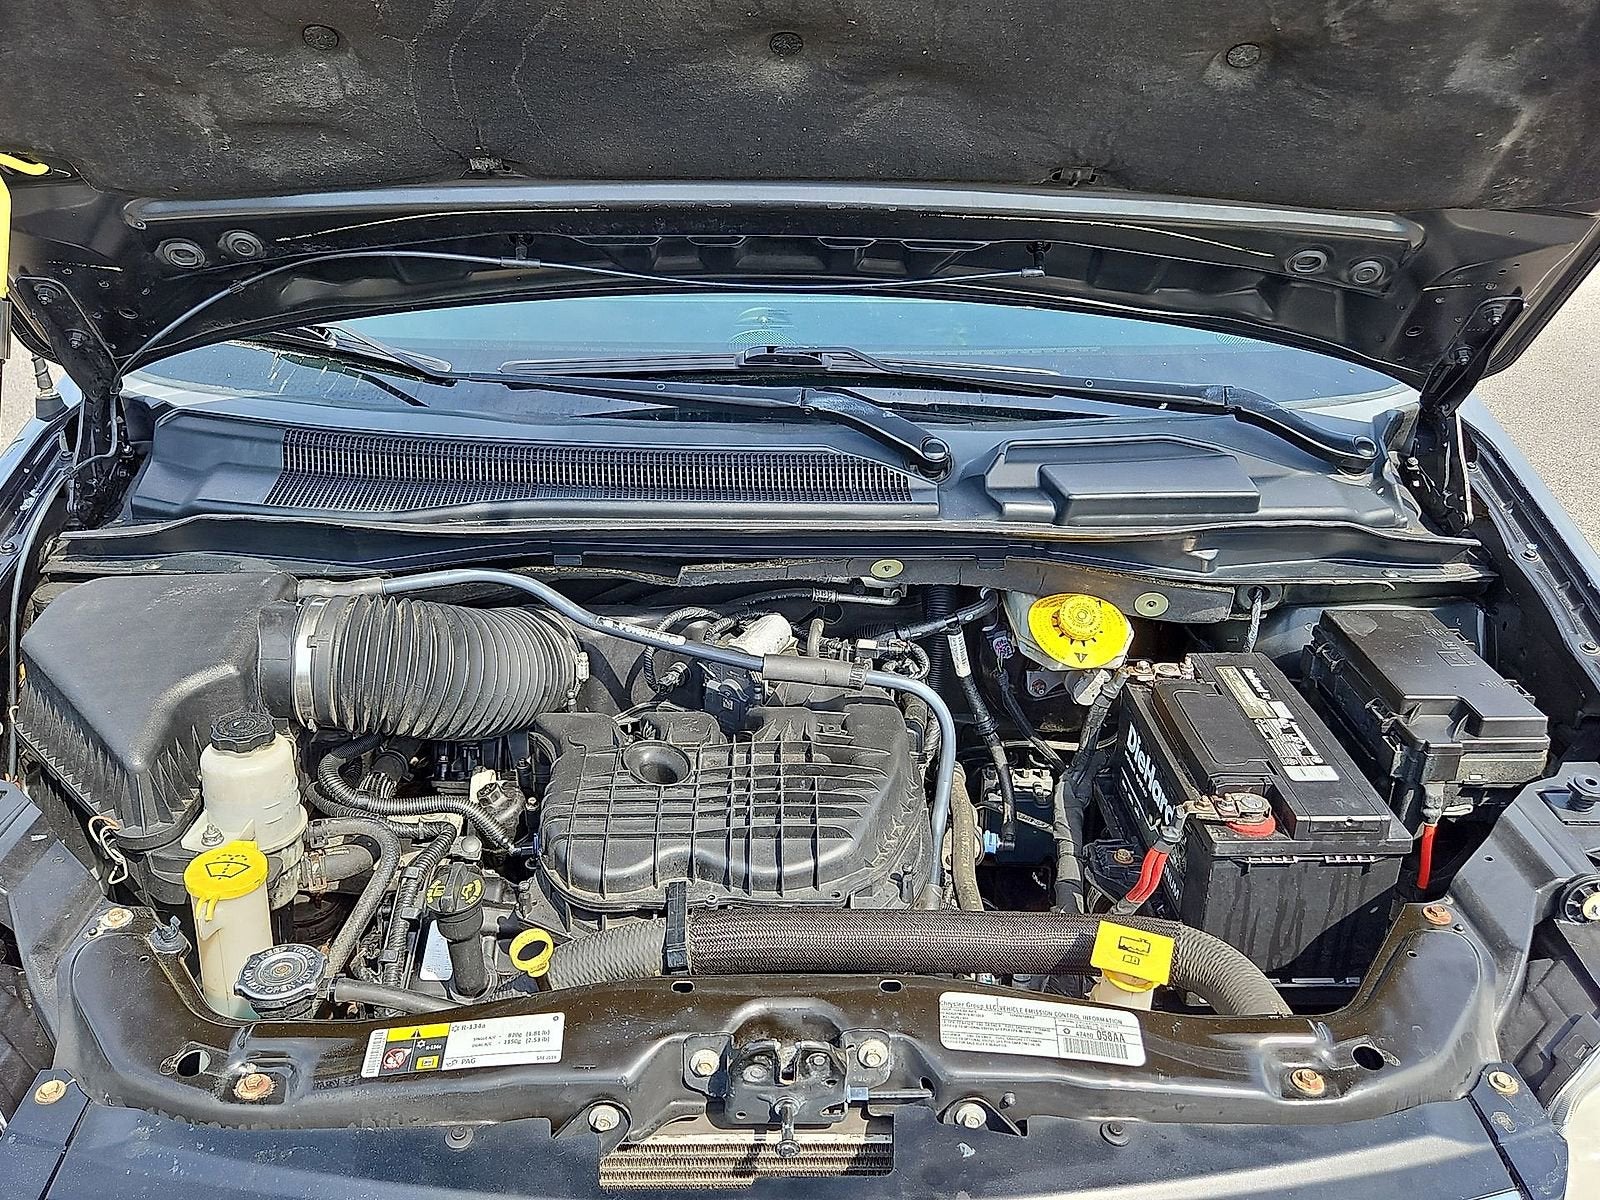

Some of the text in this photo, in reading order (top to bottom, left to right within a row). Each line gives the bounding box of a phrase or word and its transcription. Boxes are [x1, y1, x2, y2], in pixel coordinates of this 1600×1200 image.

[1126, 721, 1176, 826] DieHard
[940, 1000, 965, 1008] Chrysler
[965, 1001, 985, 1010] Group
[999, 1005, 1023, 1013] VEHICLE
[1024, 1008, 1053, 1017] EMISSION
[1054, 1011, 1080, 1020] CONTROL
[1082, 1015, 1123, 1025] INFORMATION
[461, 1023, 486, 1031] R-134a
[1096, 1030, 1126, 1043] 058AA
